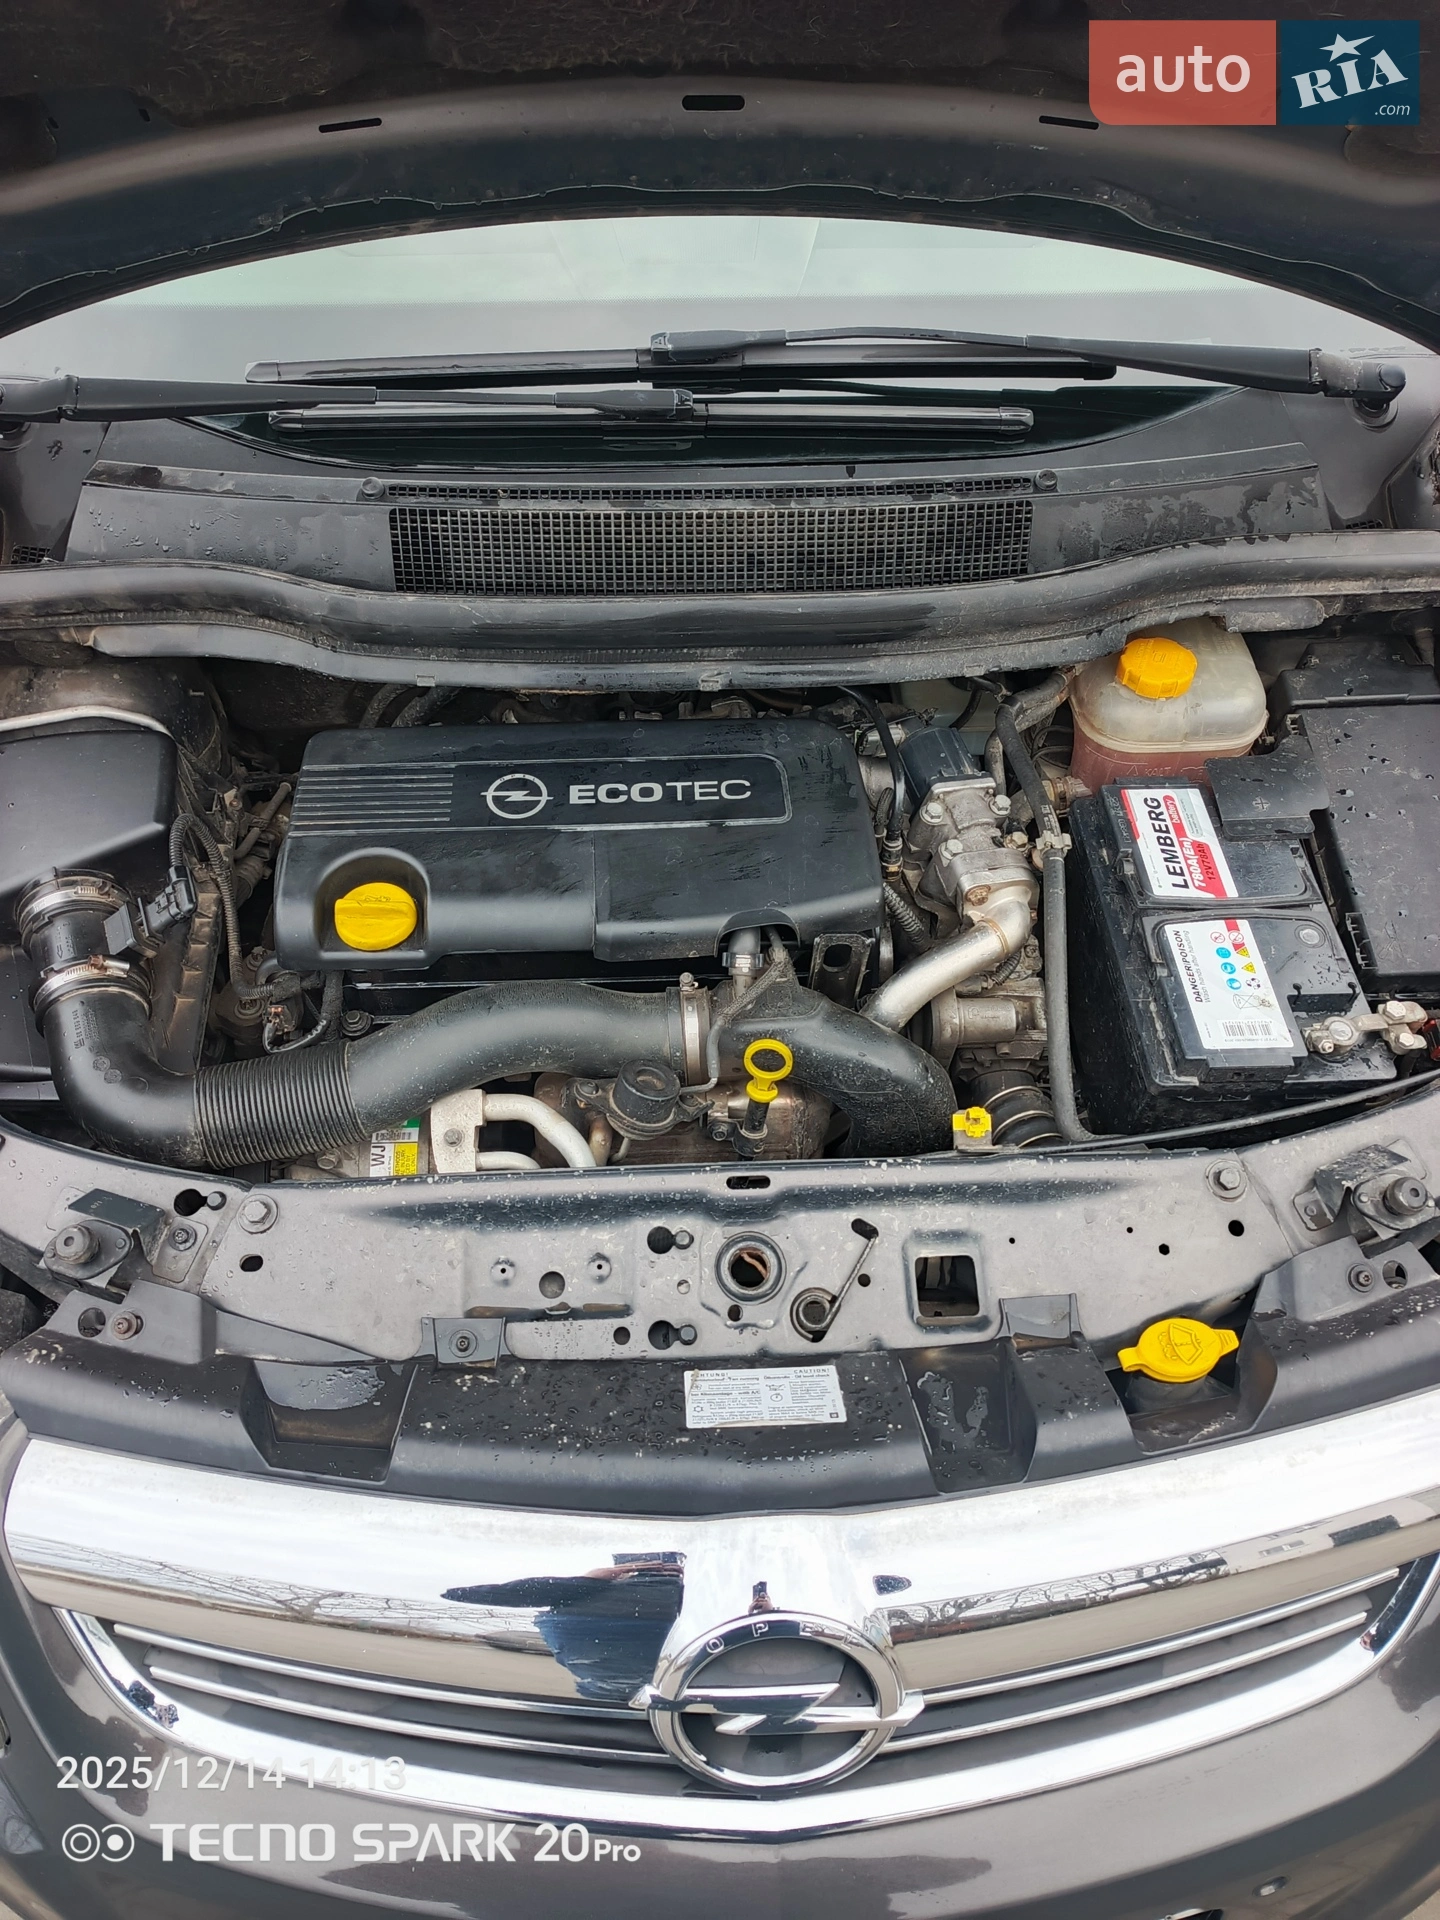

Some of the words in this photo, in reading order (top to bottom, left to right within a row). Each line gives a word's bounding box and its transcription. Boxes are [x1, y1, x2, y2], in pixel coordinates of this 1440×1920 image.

[569, 779, 751, 804] ECOTEC
[1164, 799, 1181, 823] battery
[1143, 797, 1190, 889] LEMBERG
[1180, 837, 1206, 887] 780A(En)
[1197, 843, 1216, 880] 12V78Ah
[1183, 930, 1195, 954] handling
[1196, 968, 1205, 986] hands
[1202, 986, 1211, 1003] Wash
[370, 1145, 386, 1167] WJ
